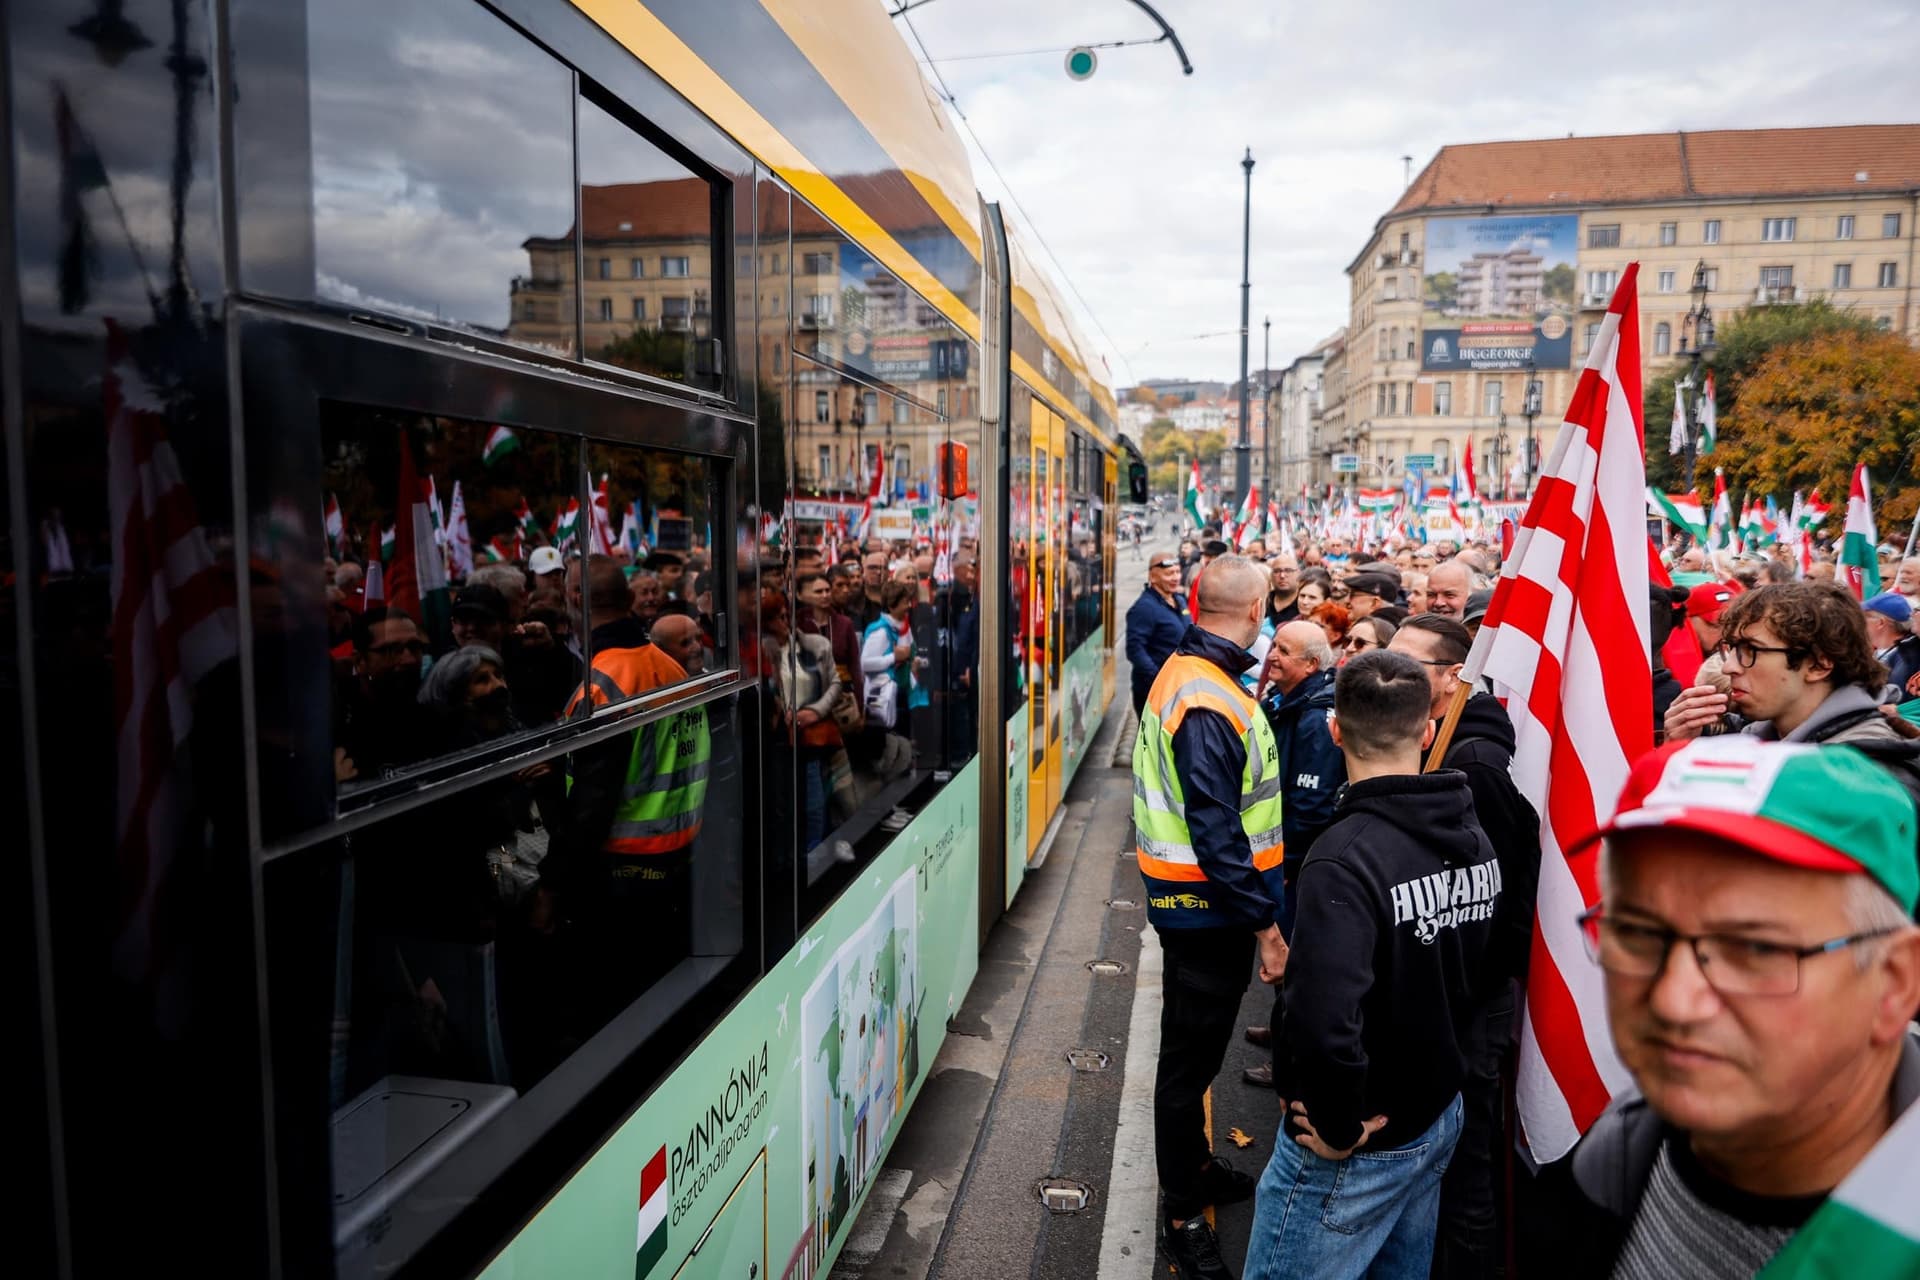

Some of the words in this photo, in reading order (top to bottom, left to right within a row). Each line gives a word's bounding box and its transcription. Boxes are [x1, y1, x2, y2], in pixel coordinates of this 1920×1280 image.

[1459, 347, 1532, 360] BIGGEORGE
[671, 1040, 768, 1197] PANNÓNIA
[672, 1089, 768, 1227] ösztöndíjprogram
